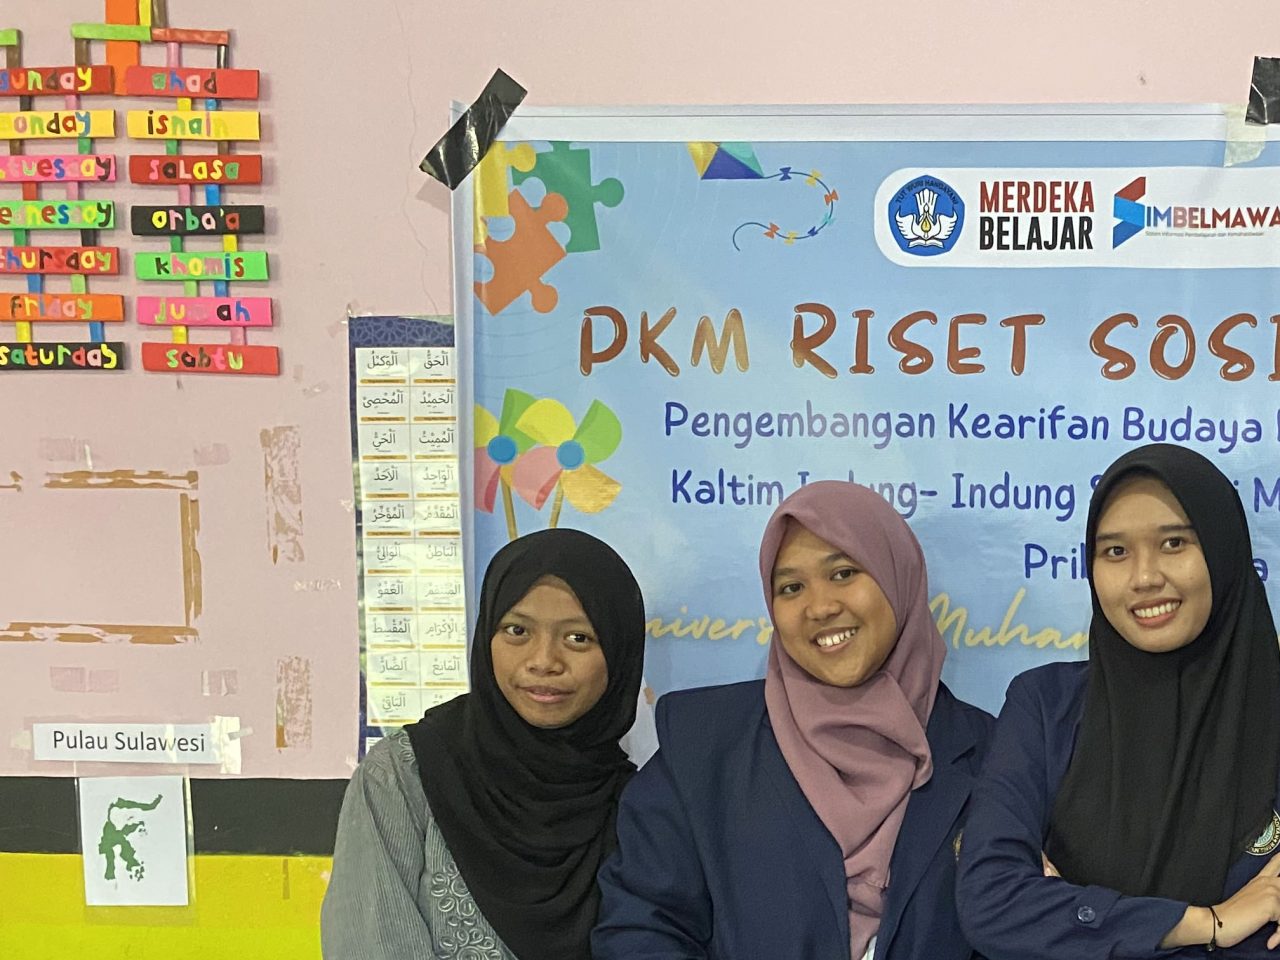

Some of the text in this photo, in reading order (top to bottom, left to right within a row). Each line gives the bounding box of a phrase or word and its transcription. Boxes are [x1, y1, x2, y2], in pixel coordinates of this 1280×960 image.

[152, 70, 217, 94] ahad
[980, 180, 1094, 214] MERDEKA
[980, 216, 1093, 251] BELAJAR
[579, 306, 749, 377] PKM
[790, 302, 1046, 378] RISET
[664, 399, 935, 450] Pengembangan
[948, 402, 1109, 441] Kearifan
[1122, 405, 1262, 454] Budaya
[671, 468, 784, 506] Kaltim
[951, 472, 1075, 521] Indung
[53, 730, 205, 752] Pulau Sulawesi
